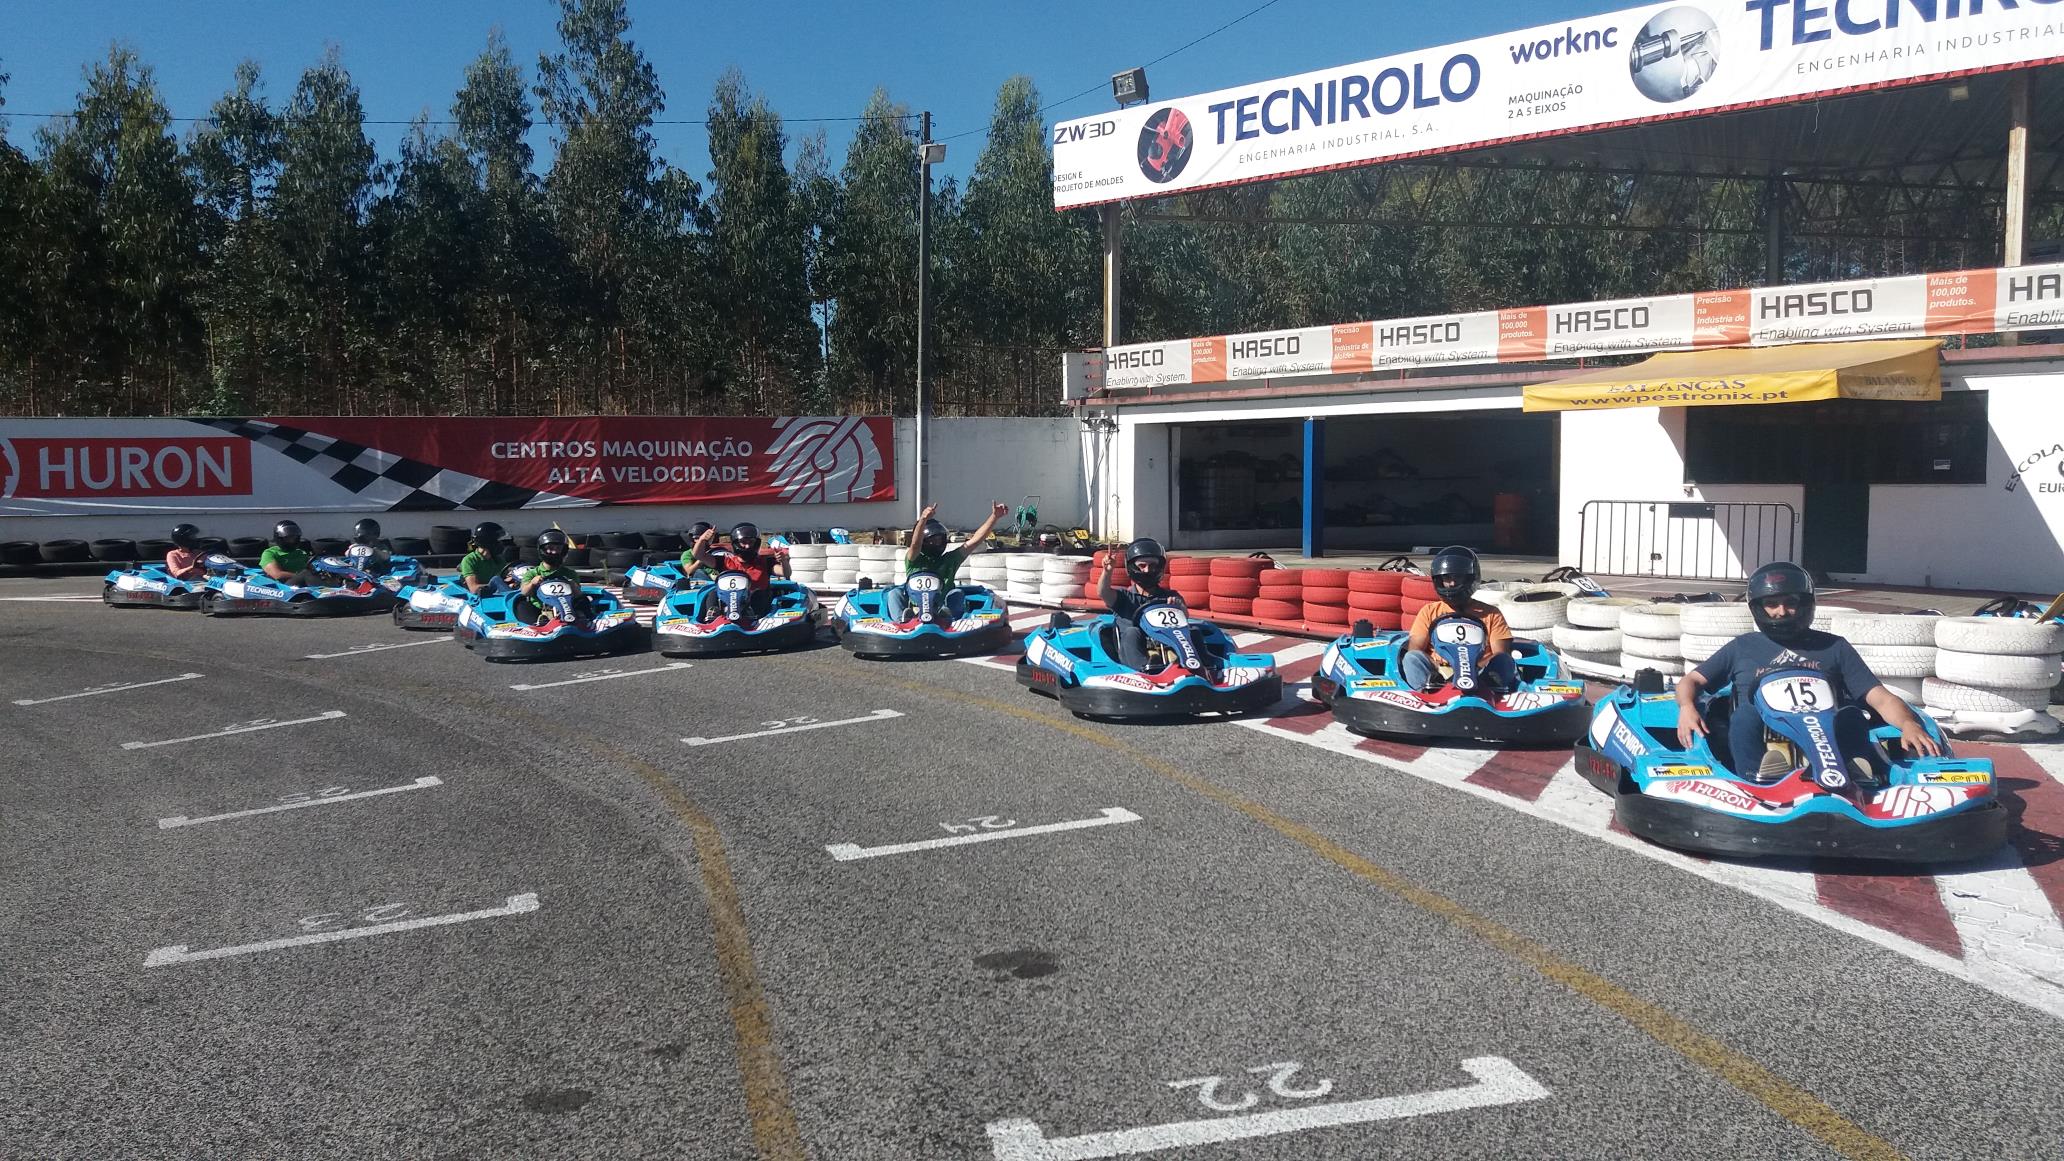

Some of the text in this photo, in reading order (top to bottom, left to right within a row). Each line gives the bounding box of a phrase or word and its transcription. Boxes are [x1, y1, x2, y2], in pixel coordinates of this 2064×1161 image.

[1509, 27, 1618, 64] worknc
[1797, 43, 1925, 75] ENGENHARIA
[1208, 53, 1481, 144] TECNIROLO
[1508, 83, 1583, 105] MAQUINAÇÃO
[1508, 102, 1566, 119] 2 A 5 EIXOS
[1239, 142, 1317, 164] ENGENHARIA
[1322, 128, 1405, 149] INDUSTRIAL,
[1085, 181, 1094, 189] DE
[1095, 176, 1124, 186] MOLDES
[1930, 275, 1968, 286] Mais de
[1930, 286, 1967, 297] 100,000
[1697, 296, 1732, 304] Precisão
[1760, 289, 1873, 319] HASCO
[1929, 298, 1976, 310] produtos.
[1501, 312, 1528, 321] Mais de
[1556, 306, 1649, 334] HASCO
[1697, 313, 1745, 324] Indústria de
[1333, 326, 1360, 335] Precisão
[1501, 321, 1528, 330] 100,000
[1824, 325, 1850, 337] with
[1380, 322, 1461, 348] HASCO
[1501, 330, 1535, 340] produtos.
[1233, 336, 1300, 360] HASCO
[1361, 342, 1369, 350] de
[1554, 340, 1604, 353] Enabling
[1607, 338, 1631, 350] with
[1106, 349, 1164, 371] HASCO
[1425, 352, 1445, 362] with
[1269, 364, 1287, 374] with
[1139, 375, 1154, 385] with
[1571, 391, 1788, 406] www.pestronix.pt
[491, 437, 753, 461] CENTROS MAQUINAÇÃO
[39, 446, 233, 490] HURON
[547, 465, 750, 484] ALTA VELOCIDADE
[357, 547, 367, 556] 18
[549, 584, 565, 594] 22
[729, 578, 737, 589] 6
[917, 578, 932, 589] 30
[246, 585, 285, 598] TECNIROLO
[1158, 611, 1179, 625] 28
[1455, 625, 1466, 641] 9
[1117, 676, 1151, 690] HURON
[1382, 691, 1422, 709] HURON
[1783, 682, 1817, 706] 15
[1803, 716, 1838, 768] TECNIROLO
[1695, 783, 1752, 809] HURON
[939, 815, 1016, 833] 24
[1167, 1062, 1333, 1112] 22
